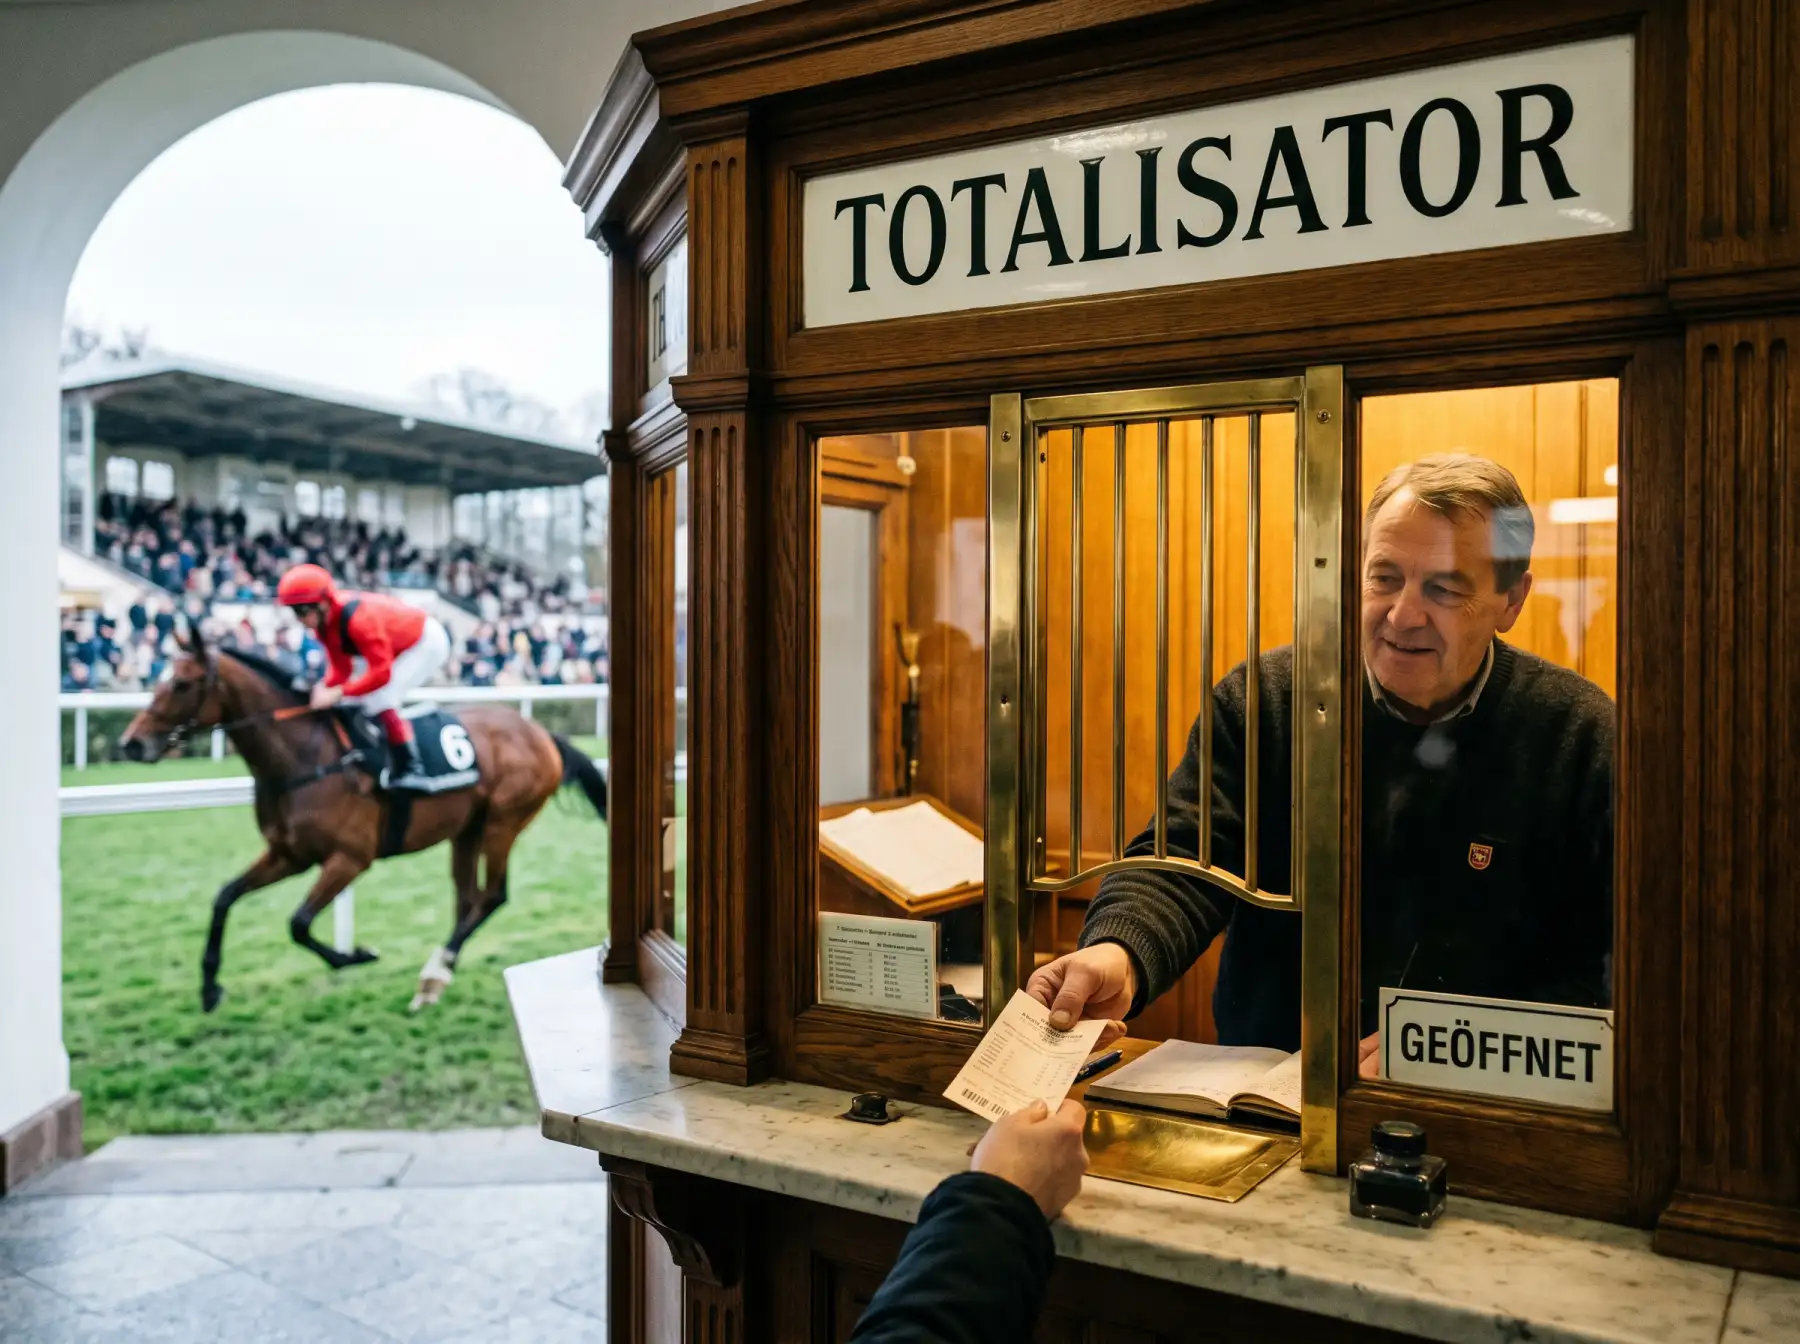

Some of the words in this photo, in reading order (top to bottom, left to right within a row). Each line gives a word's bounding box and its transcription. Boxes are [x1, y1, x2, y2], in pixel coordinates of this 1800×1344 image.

[834, 83, 1580, 293] TOTALISATOR
[440, 724, 475, 770] 6
[1401, 1019, 1602, 1083] GEÖFFNET
